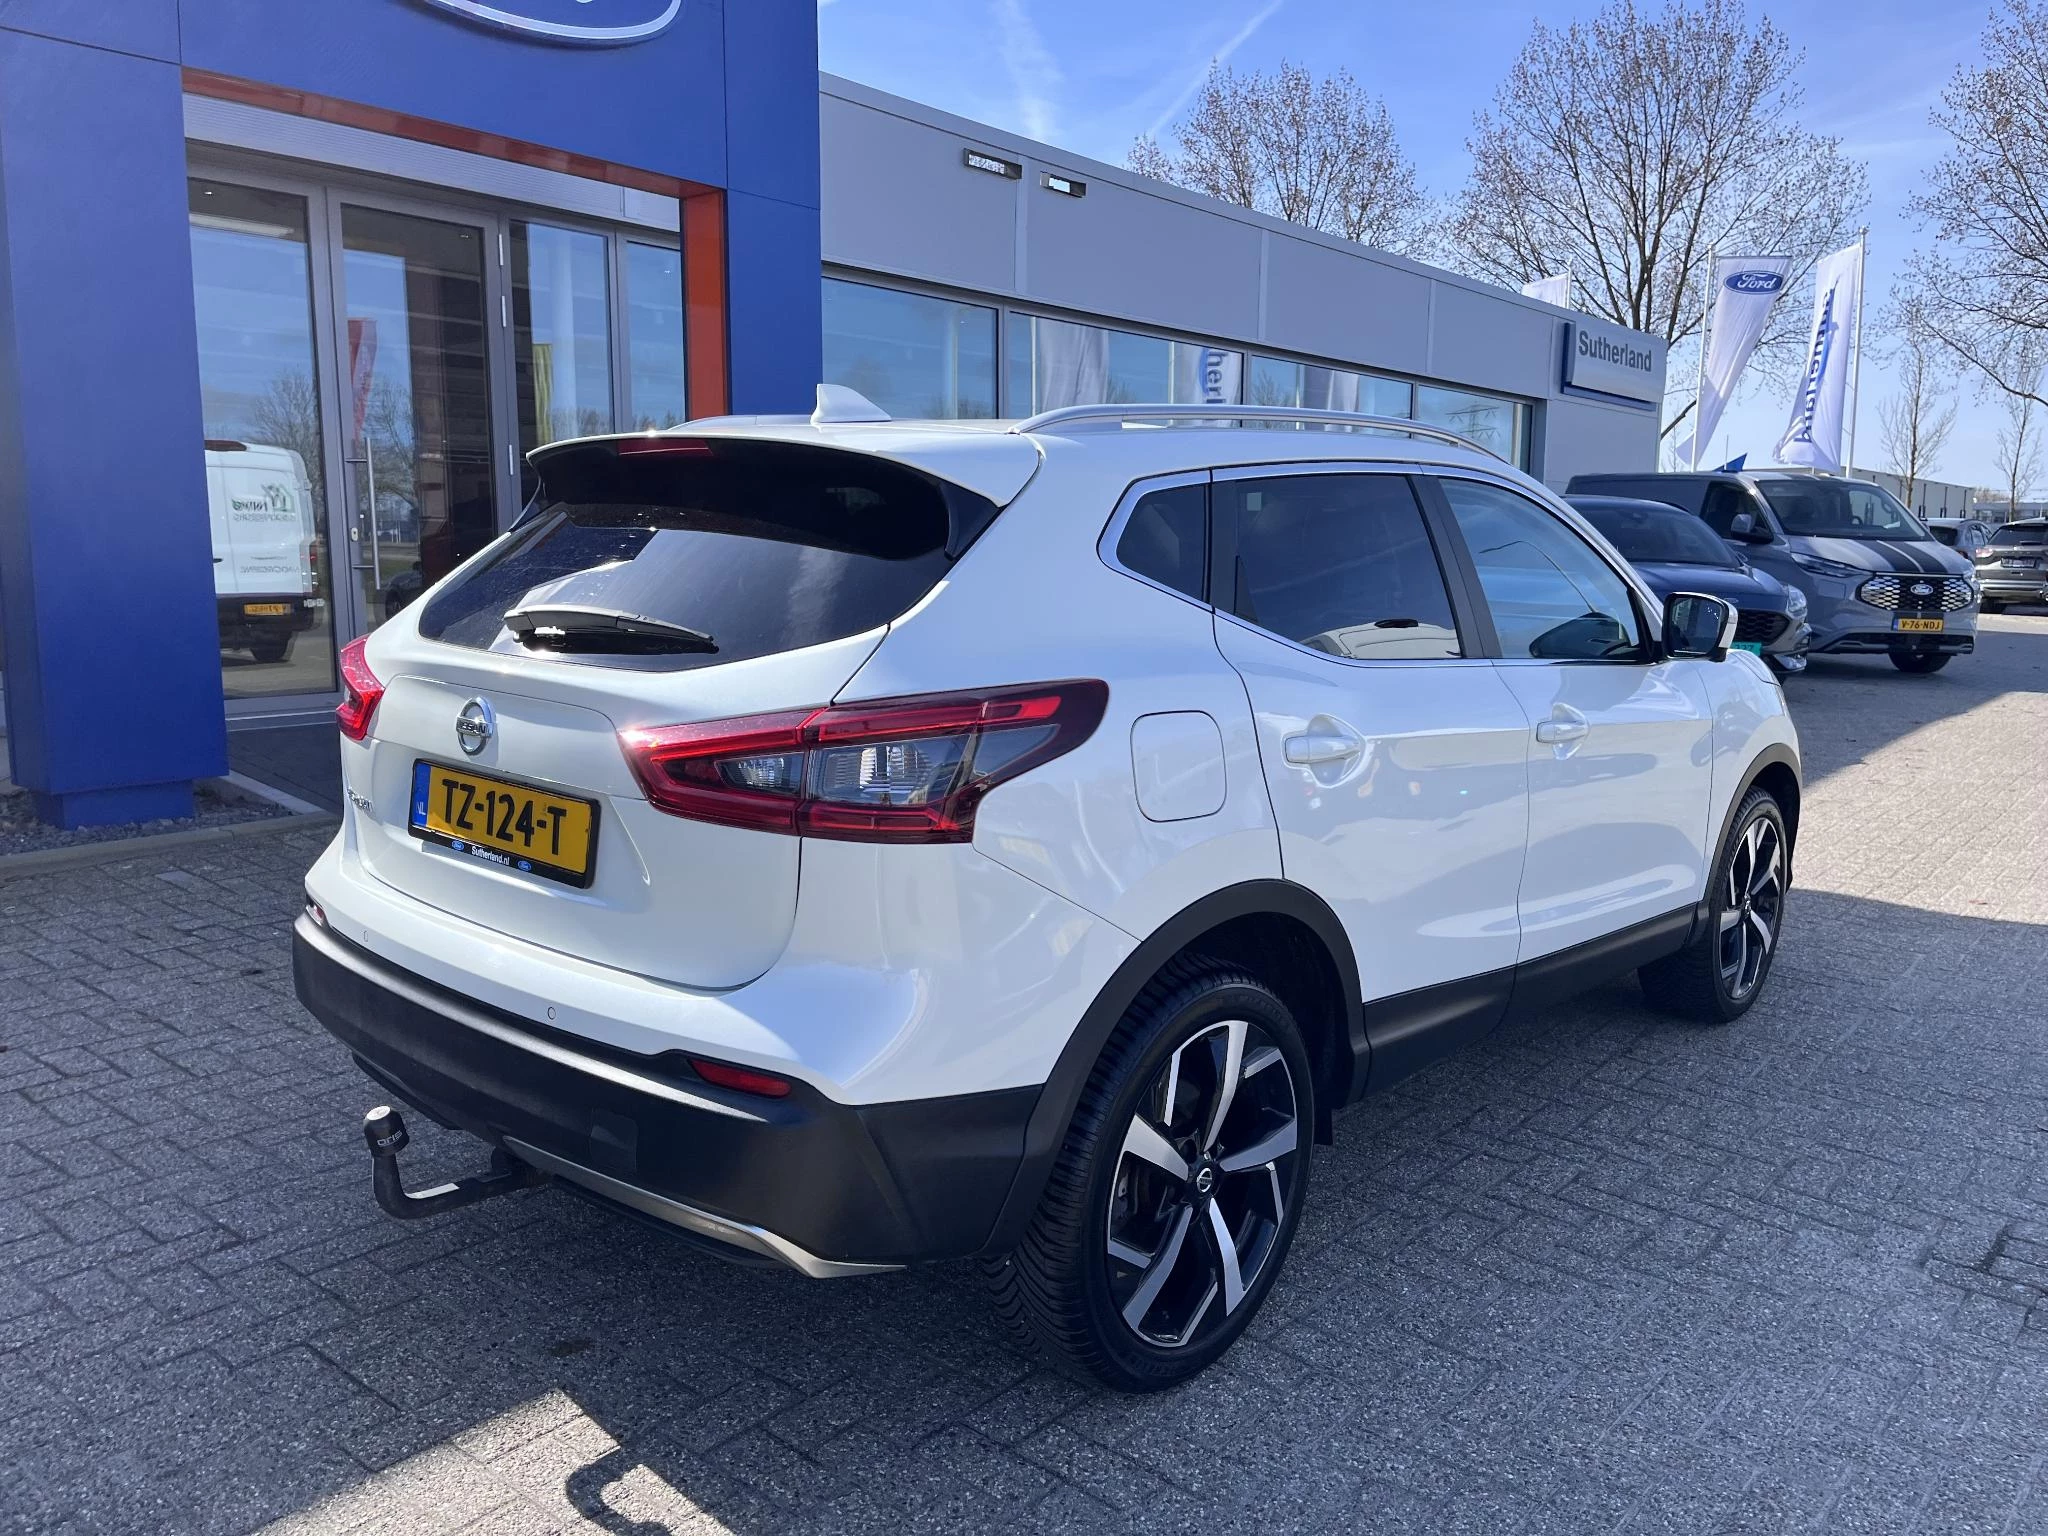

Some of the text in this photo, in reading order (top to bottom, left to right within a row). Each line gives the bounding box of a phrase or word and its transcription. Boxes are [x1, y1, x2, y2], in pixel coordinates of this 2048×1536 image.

[1737, 273, 1777, 289] Ford
[1578, 330, 1652, 373] Sutherland
[1901, 620, 1940, 630] V-76-NDJ
[442, 779, 567, 856] TZ-124-T
[471, 845, 510, 866] Sutherland.nl
